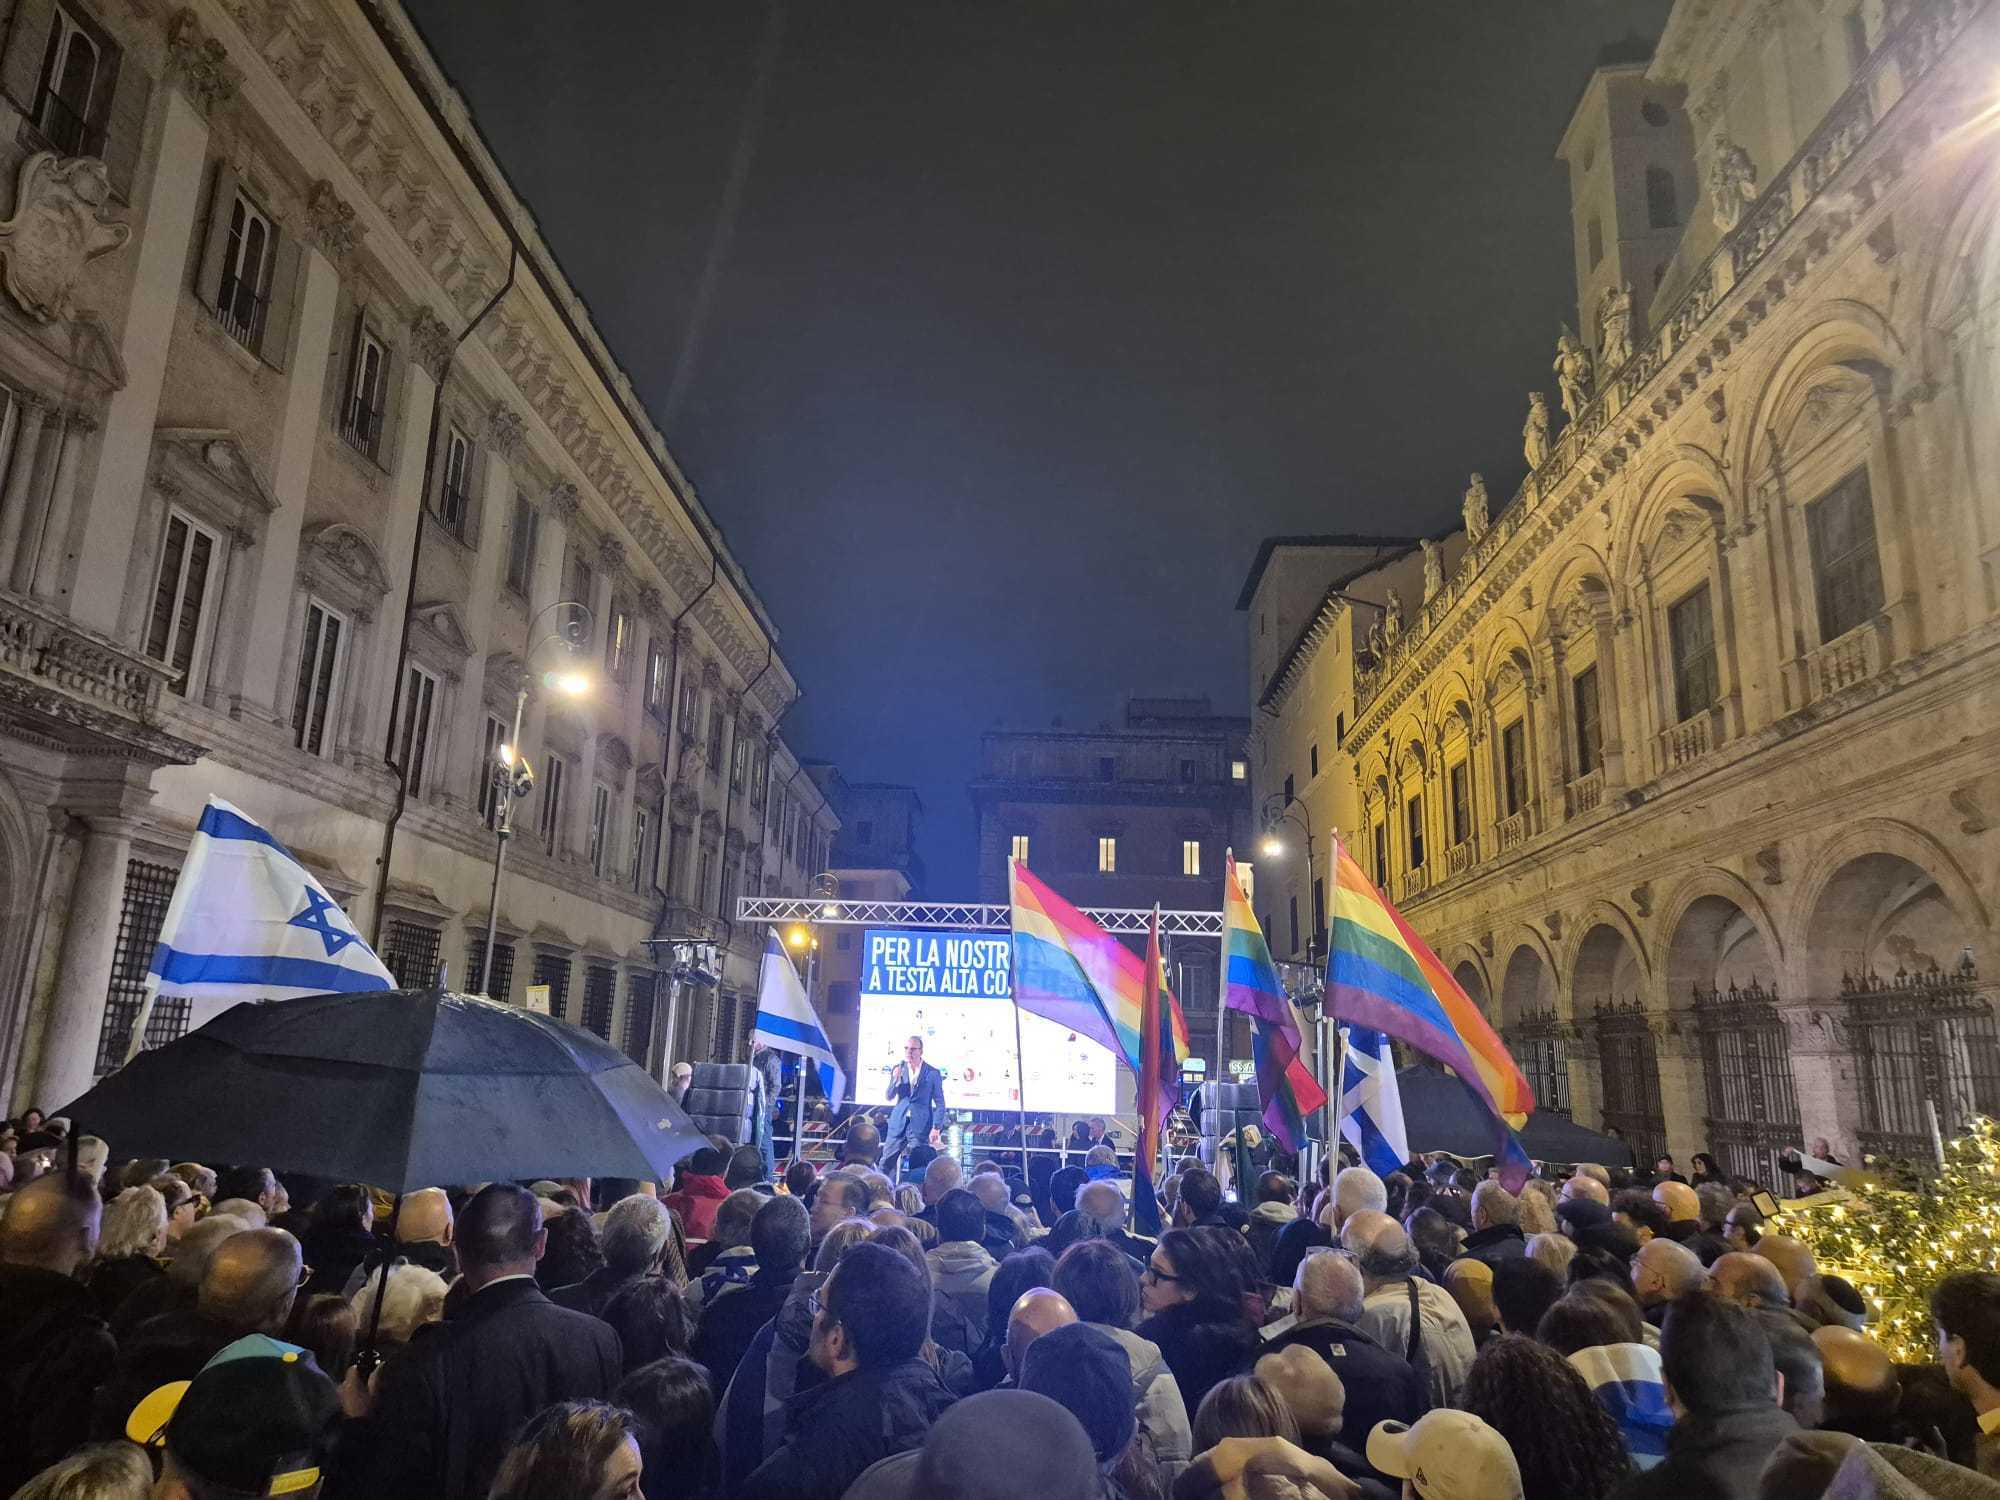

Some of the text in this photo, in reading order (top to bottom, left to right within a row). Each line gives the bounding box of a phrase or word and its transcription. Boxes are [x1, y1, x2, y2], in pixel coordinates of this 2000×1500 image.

[872, 936, 1010, 970] PER LA NOSTR
[869, 965, 1012, 997] A TESTA ALTA CO
